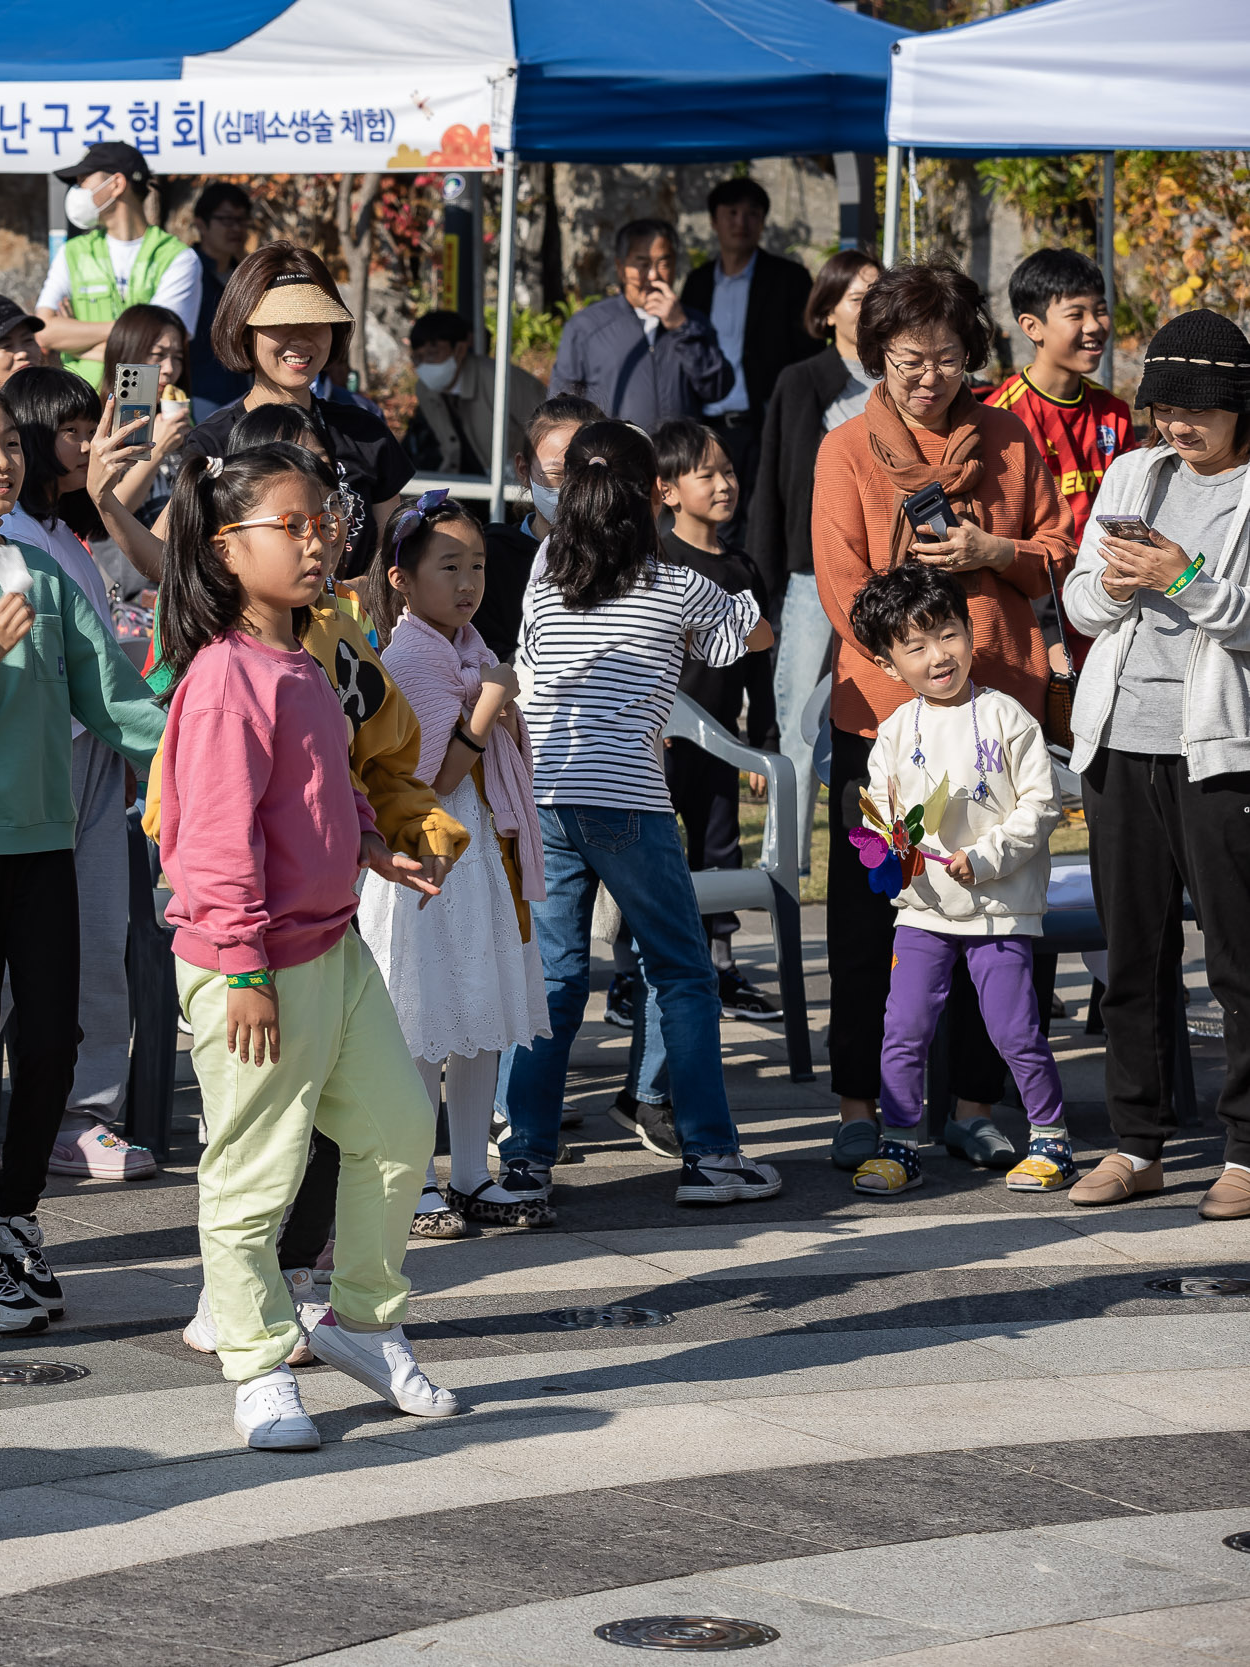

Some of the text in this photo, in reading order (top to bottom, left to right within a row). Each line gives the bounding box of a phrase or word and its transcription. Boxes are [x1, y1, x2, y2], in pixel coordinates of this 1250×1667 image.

[214, 110, 334, 145] (심폐소생술
[341, 108, 396, 143] 체험)
[974, 738, 1004, 774] NY
